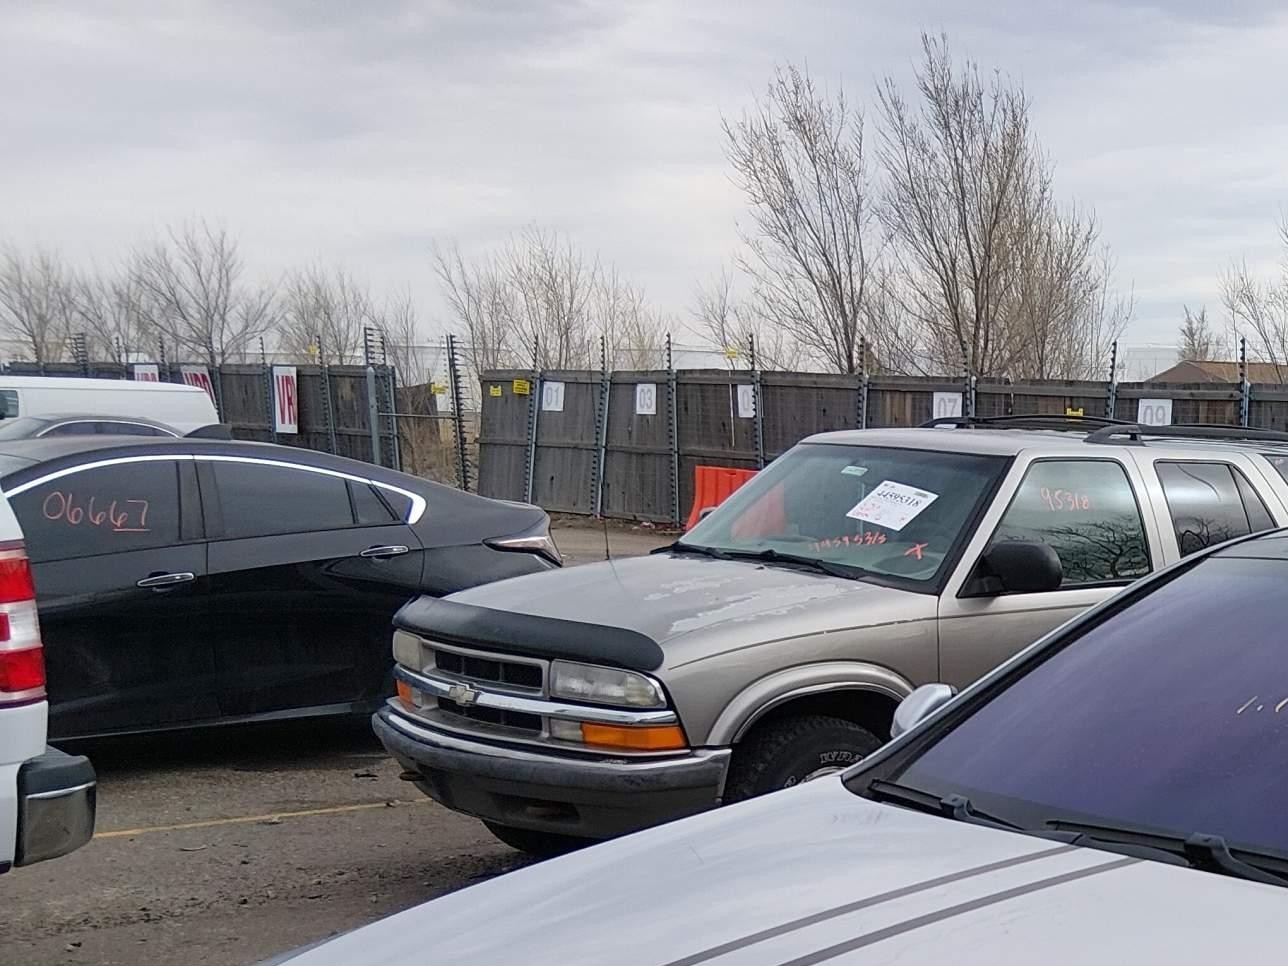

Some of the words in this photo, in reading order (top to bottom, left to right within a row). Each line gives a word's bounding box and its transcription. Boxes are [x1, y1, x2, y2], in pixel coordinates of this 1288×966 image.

[545, 386, 560, 406] 01
[639, 388, 653, 409] 03
[938, 397, 957, 417] 07
[1143, 405, 1165, 425] 09
[43, 491, 149, 528] 06667
